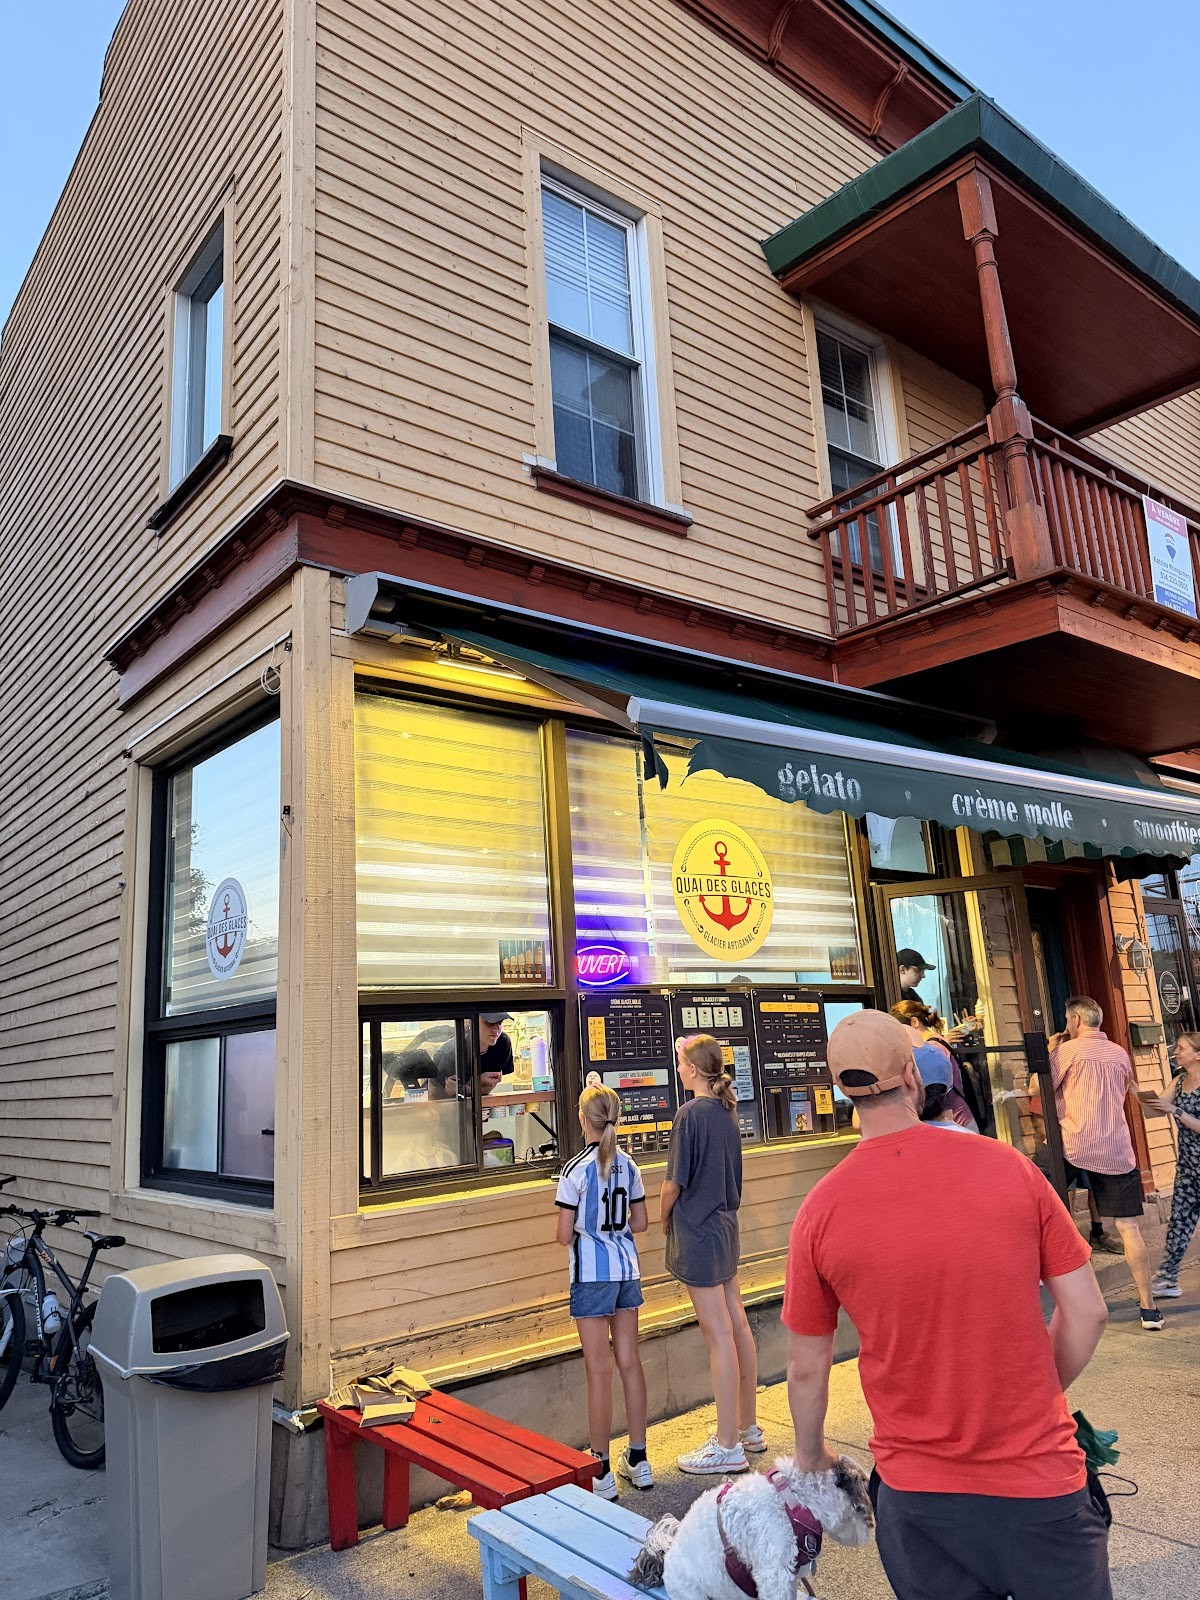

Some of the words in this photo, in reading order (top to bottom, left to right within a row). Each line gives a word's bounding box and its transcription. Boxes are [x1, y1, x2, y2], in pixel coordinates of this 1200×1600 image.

[1156, 507, 1181, 526] VENDRE
[777, 762, 862, 800] gelato
[951, 789, 1019, 823] crème
[1023, 801, 1075, 830] molle
[675, 876, 703, 894] QUAI
[706, 878, 728, 893] DES
[731, 880, 771, 898] GLACES
[207, 926, 218, 940] QUAI
[218, 922, 228, 934] DES
[228, 915, 247, 931] GLACES
[703, 930, 727, 950] GLACIER
[727, 933, 756, 951] ARTISANAL
[576, 953, 628, 975] UVERT
[601, 1187, 628, 1232] 10
